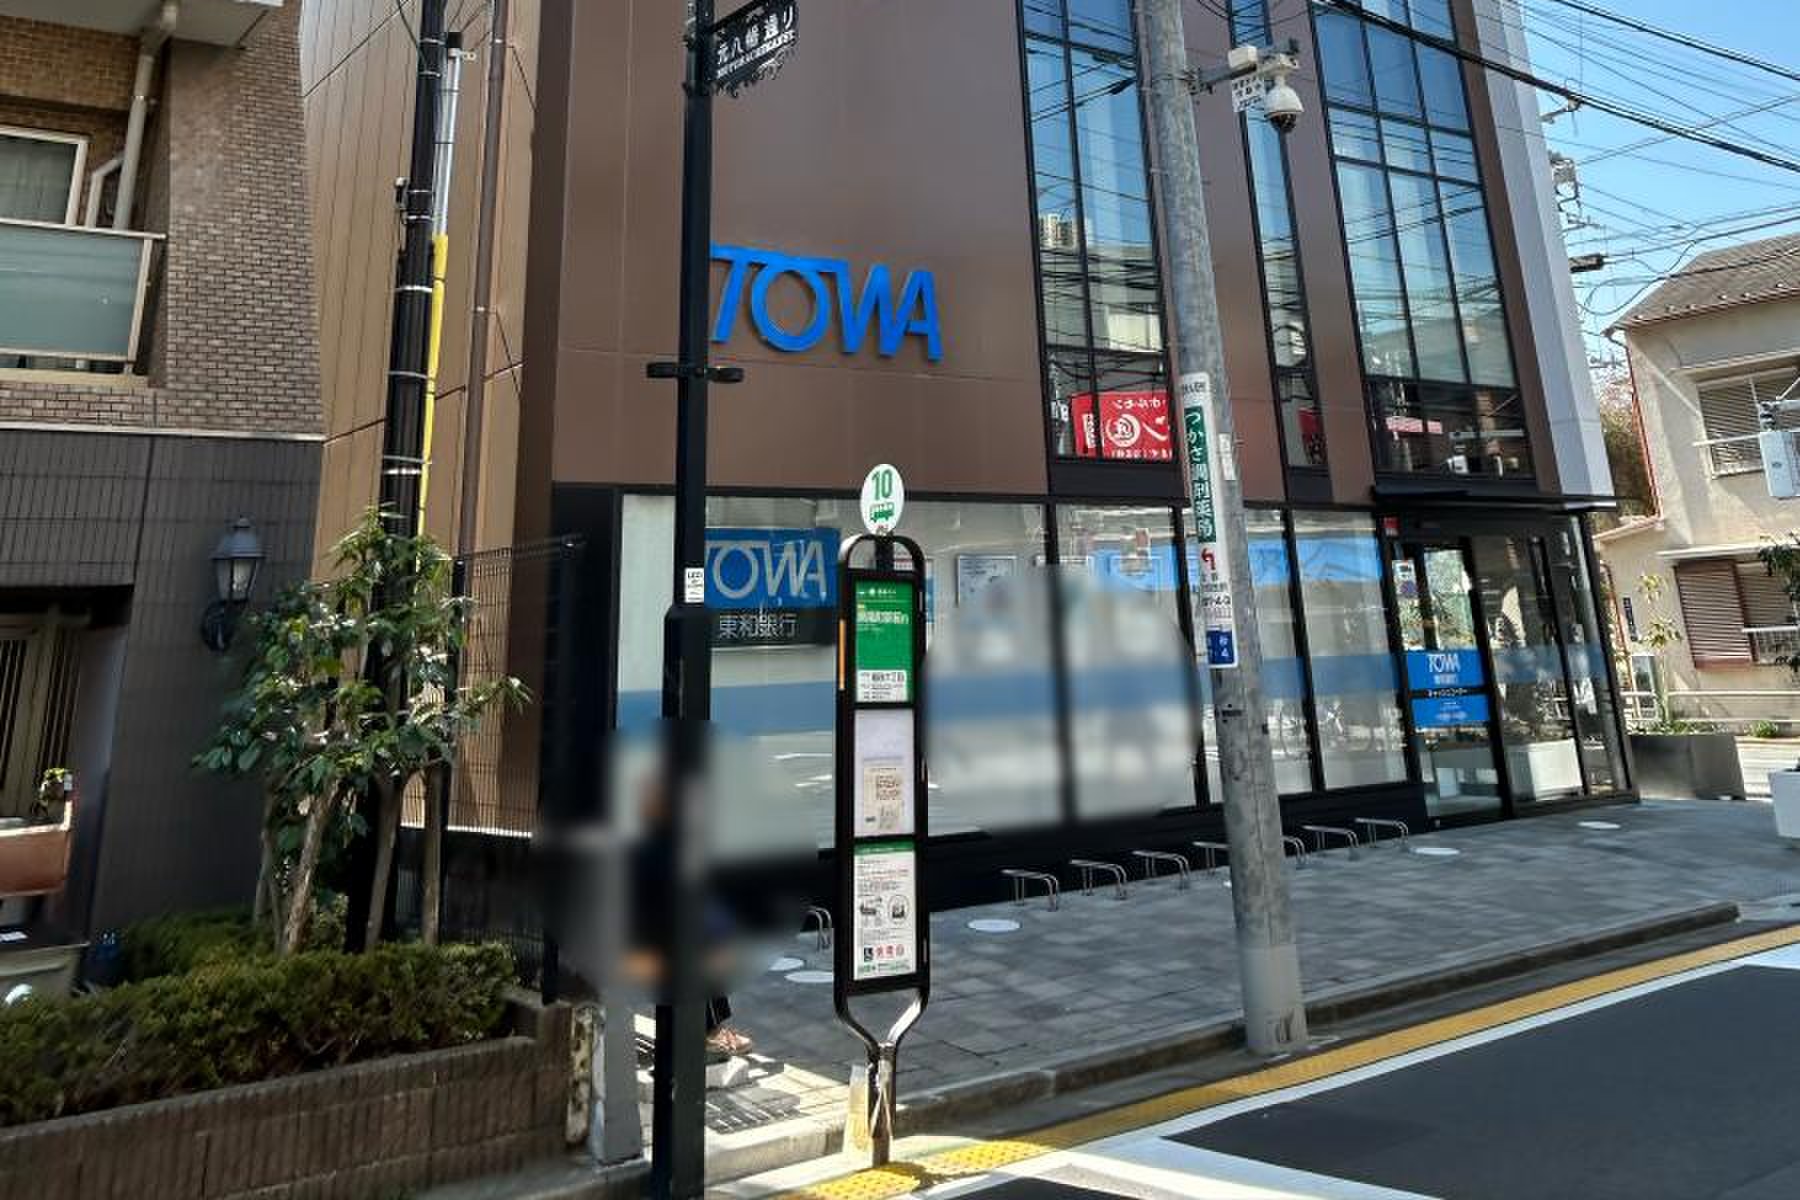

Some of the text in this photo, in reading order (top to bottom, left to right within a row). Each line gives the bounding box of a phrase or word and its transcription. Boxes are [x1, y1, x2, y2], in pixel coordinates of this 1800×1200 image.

[711, 243, 943, 360] TOWA
[872, 469, 893, 500] 10
[719, 613, 796, 639] 東和銀行
